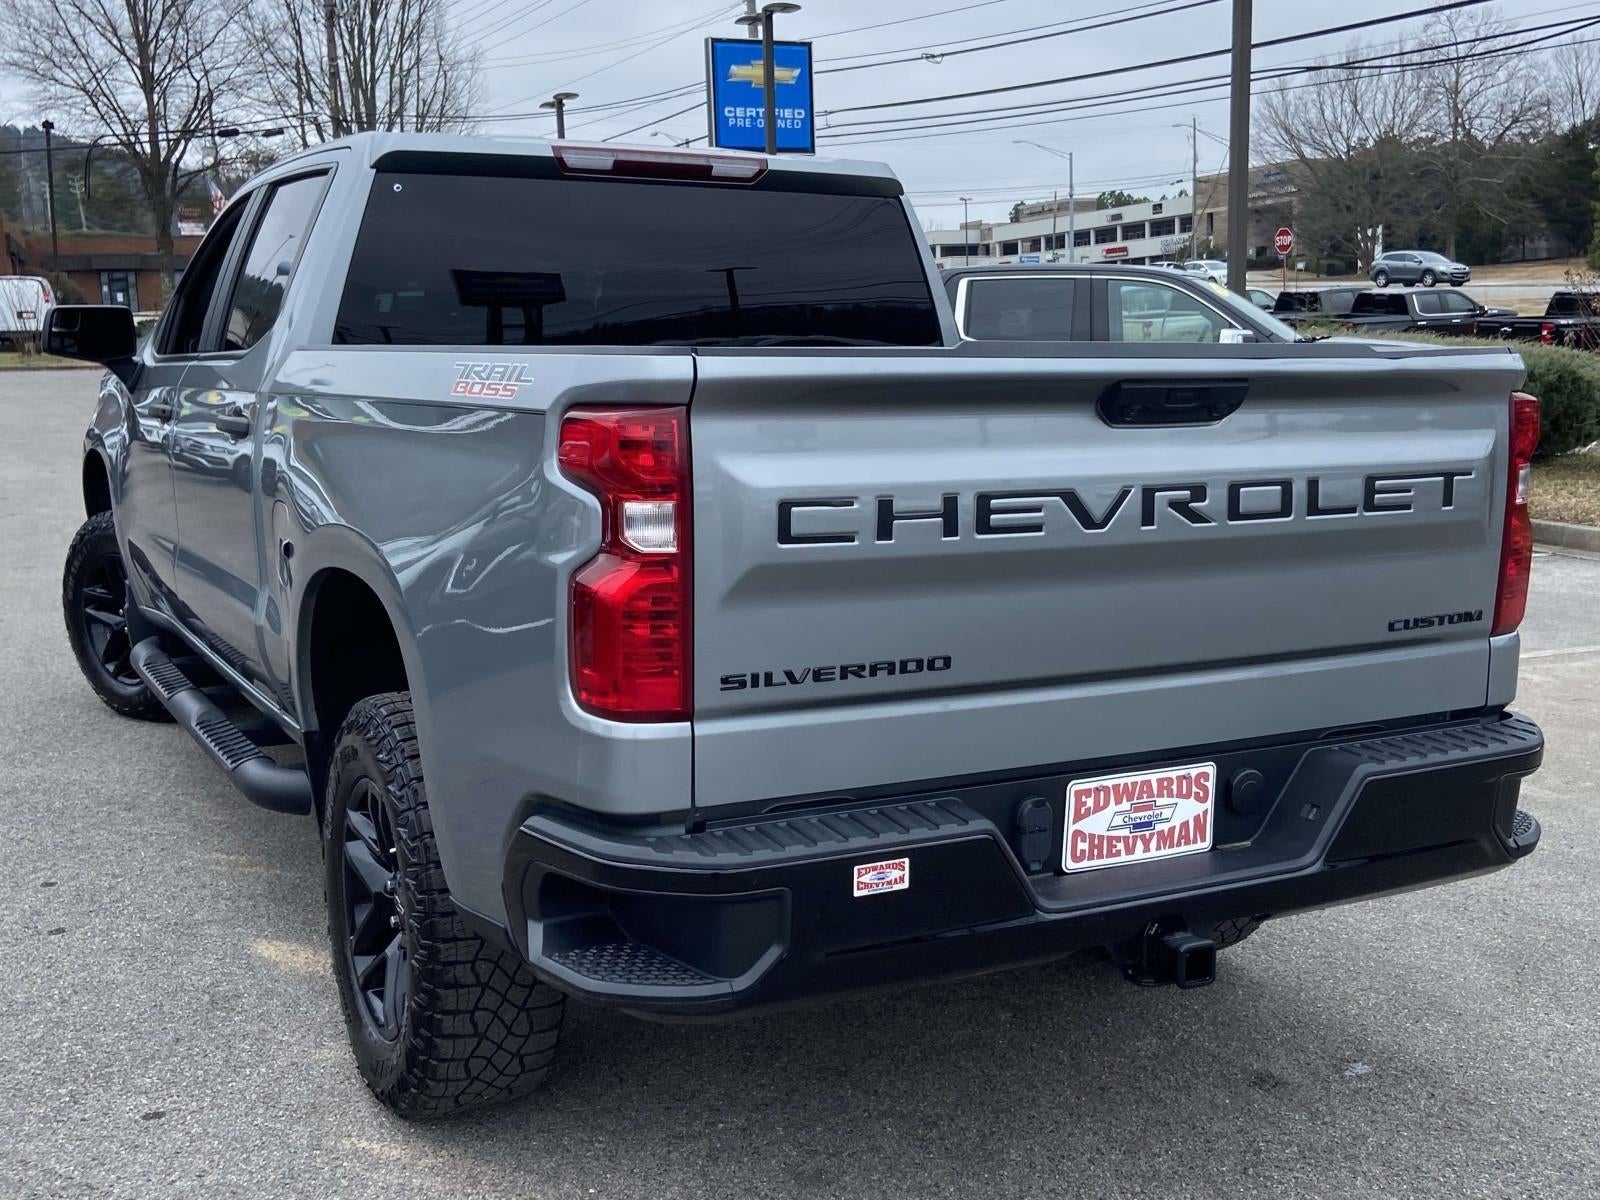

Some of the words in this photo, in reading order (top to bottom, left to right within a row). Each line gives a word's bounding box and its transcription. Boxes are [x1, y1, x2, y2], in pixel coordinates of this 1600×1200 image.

[724, 107, 805, 119] CERTIED
[728, 118, 802, 129] PRE-ONED
[1276, 235, 1292, 246] STOP
[453, 361, 534, 385] TRAIL
[450, 380, 519, 399] BOSS
[778, 469, 1475, 547] CHEVROLET
[1388, 610, 1483, 632] CUSTOM
[719, 654, 952, 691] SILVERADO
[1072, 771, 1210, 825] EDWARDS
[1122, 811, 1163, 824] Chevrolet
[1070, 808, 1209, 863] CHEVYMAN
[857, 861, 906, 880] EDWARDS
[857, 873, 906, 891] CHEVYMAN
